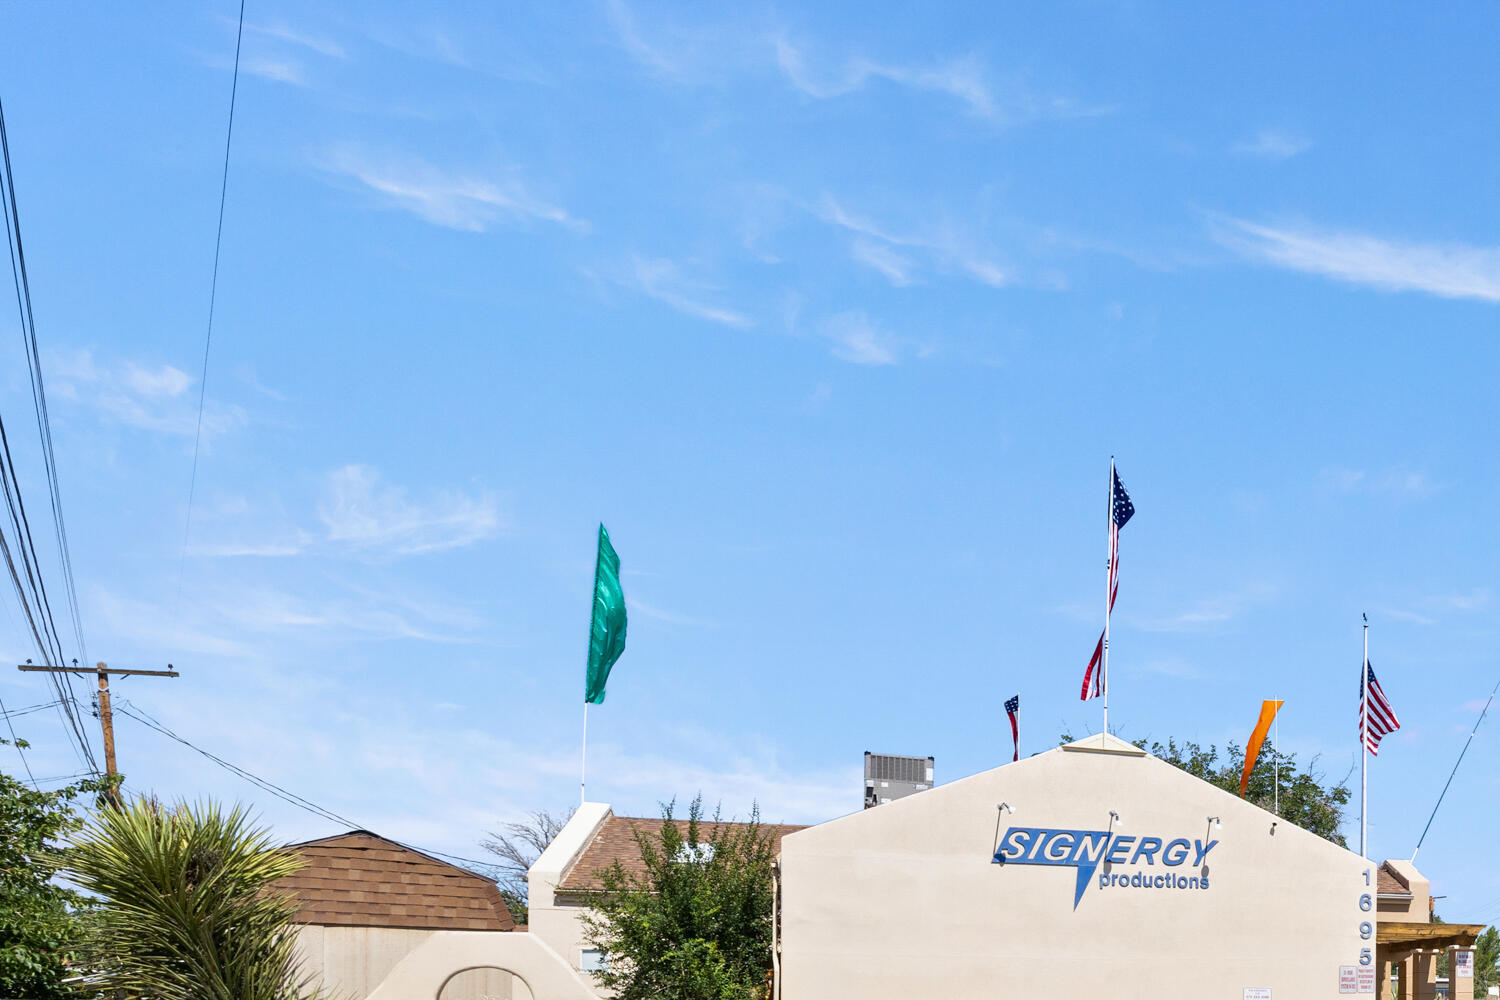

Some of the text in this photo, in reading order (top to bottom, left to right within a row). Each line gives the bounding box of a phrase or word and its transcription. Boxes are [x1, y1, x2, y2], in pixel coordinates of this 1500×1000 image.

[1001, 830, 1219, 867] SIGNERGY
[1099, 871, 1210, 890] productions
[1359, 868, 1373, 966] 1695
